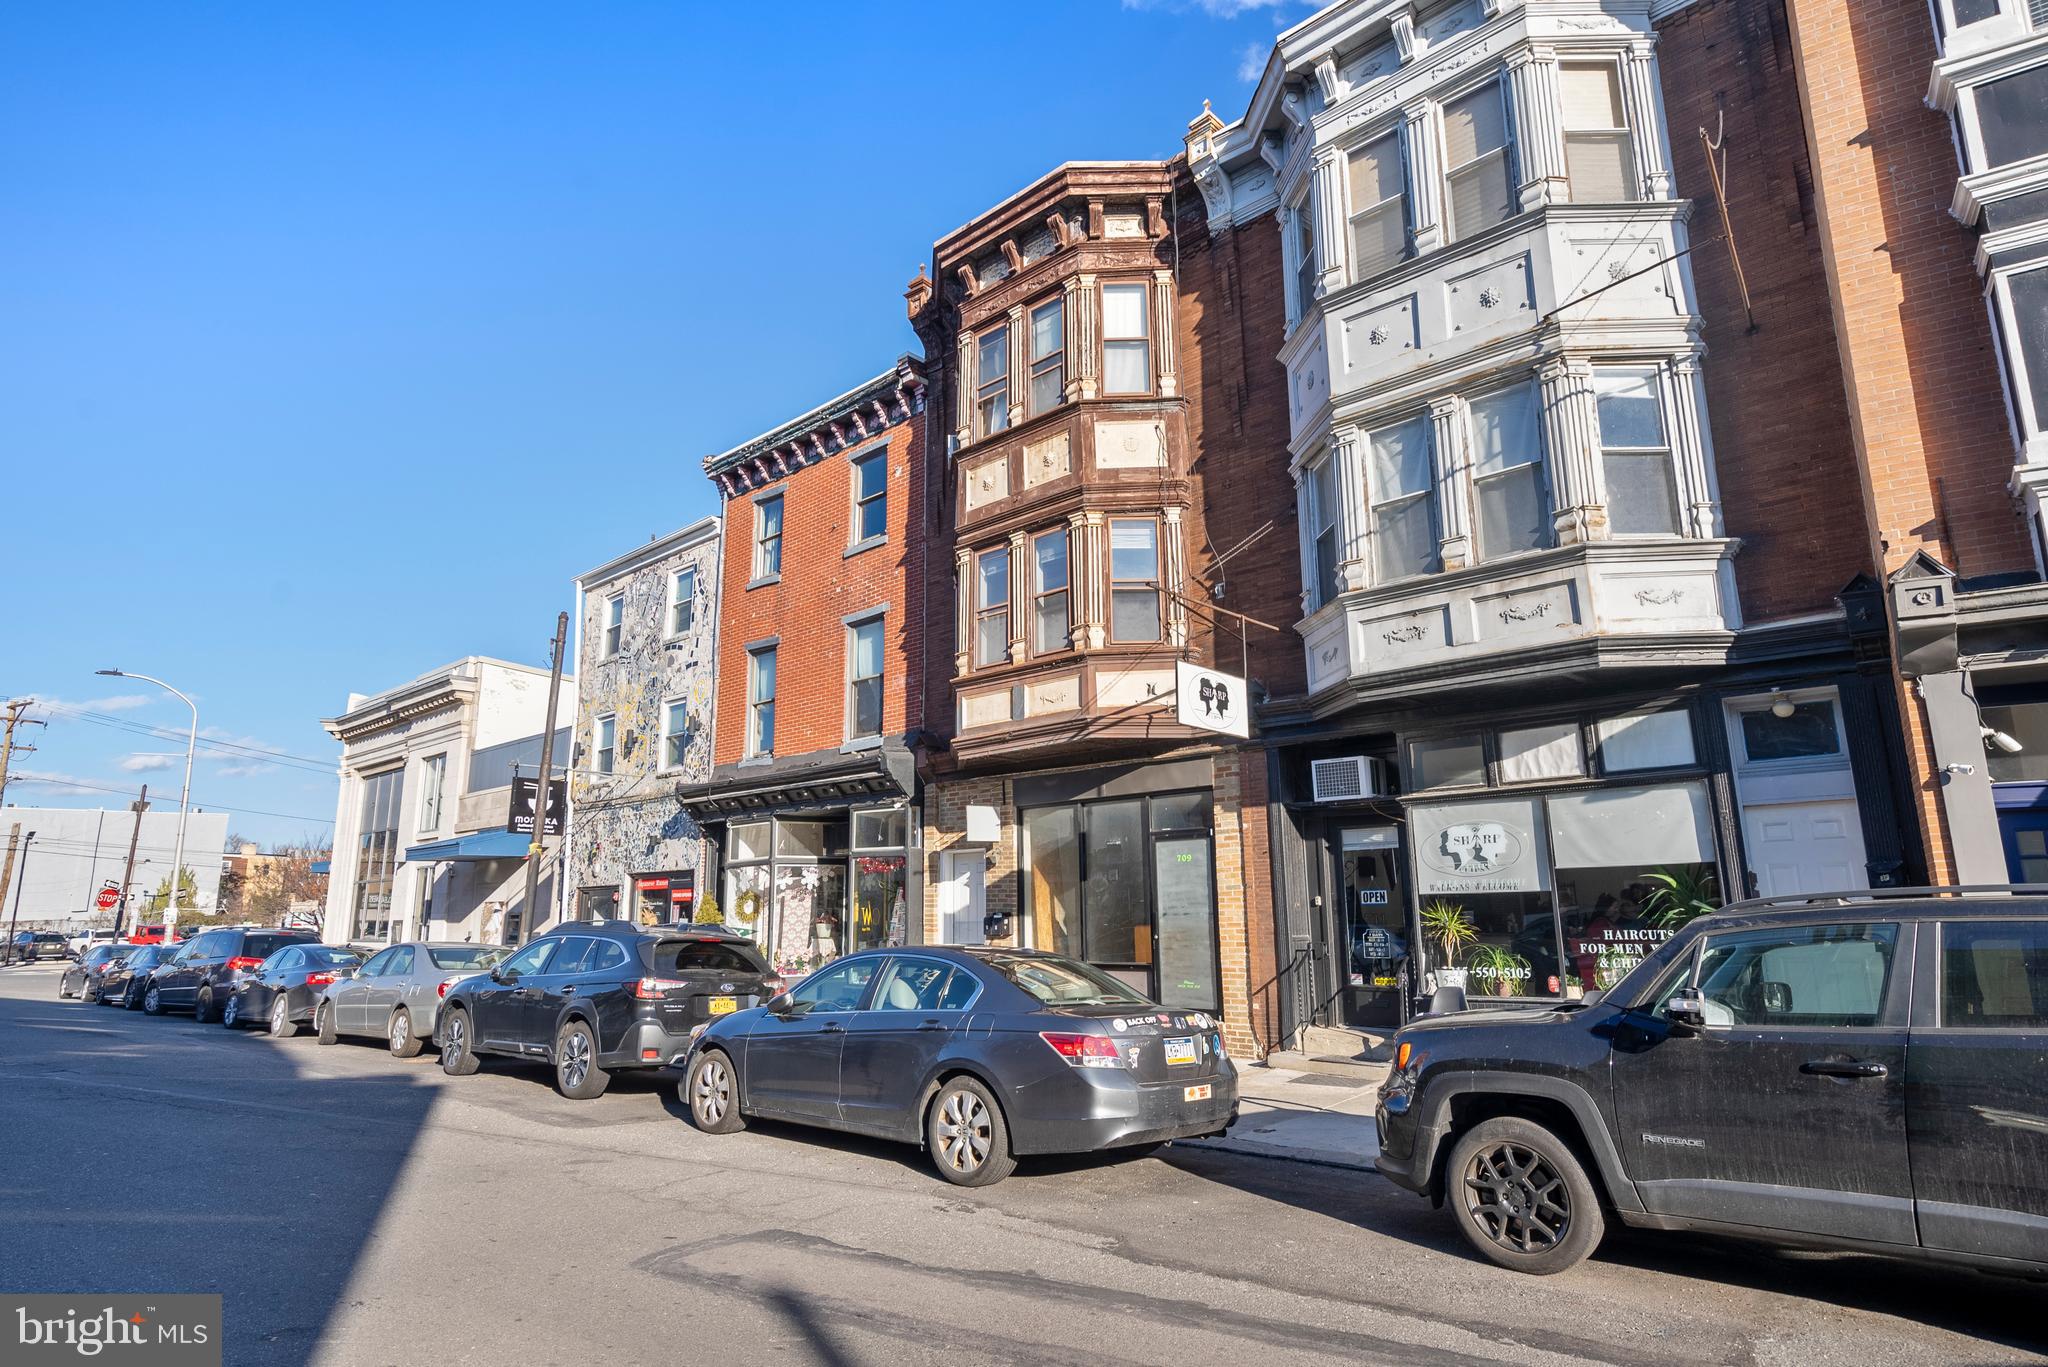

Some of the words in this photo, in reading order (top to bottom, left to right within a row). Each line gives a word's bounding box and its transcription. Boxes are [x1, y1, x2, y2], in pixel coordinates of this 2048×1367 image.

[1202, 686, 1227, 701] SHARP
[1176, 854, 1192, 862] 709
[1474, 881, 1520, 891] WELCOME
[98, 893, 118, 903] STOP
[1362, 891, 1386, 903] OPEN
[1603, 929, 1675, 940] HAIRCUTS
[1580, 943, 1607, 954] FOR
[1613, 943, 1644, 954] MEN
[1600, 957, 1609, 968] &
[1126, 1017, 1144, 1026] BACK
[1144, 1016, 1157, 1025] OFF
[1642, 1133, 1705, 1148] RENEGADE
